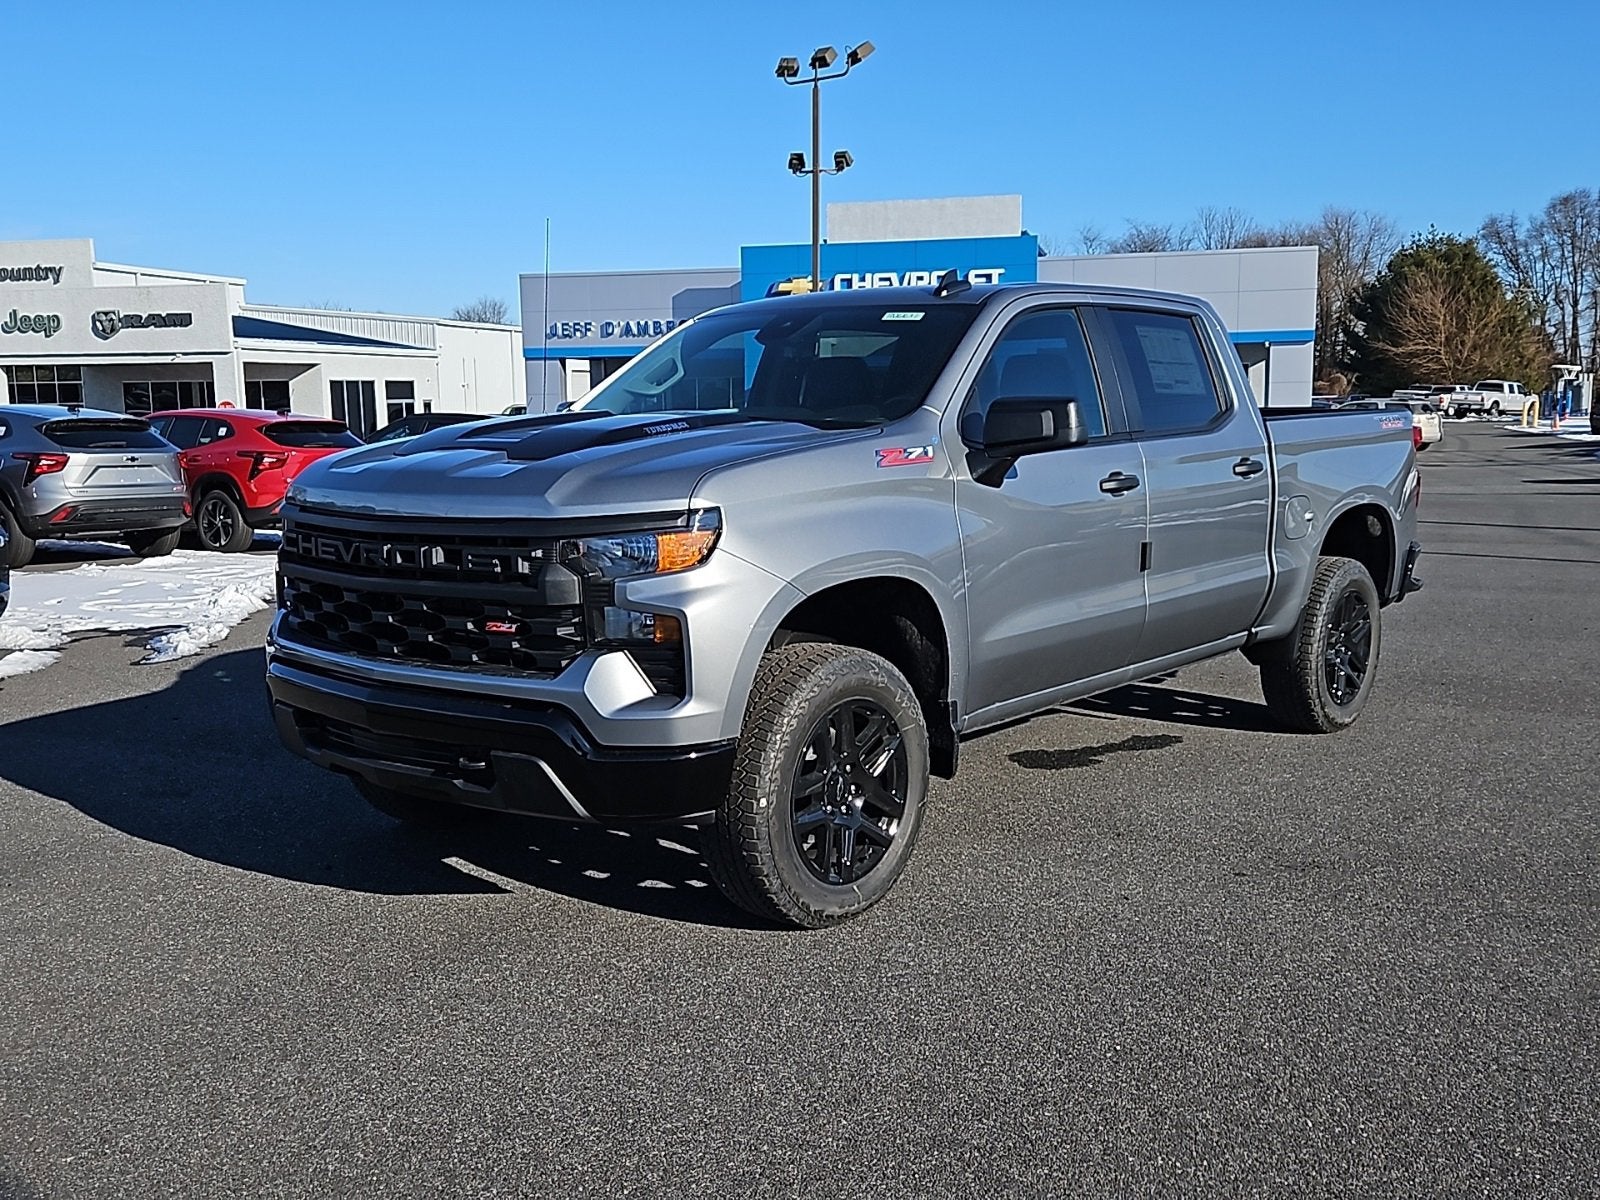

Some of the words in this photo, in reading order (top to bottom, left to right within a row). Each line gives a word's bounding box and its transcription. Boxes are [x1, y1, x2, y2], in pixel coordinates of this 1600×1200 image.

[1, 309, 61, 338] Jeep
[121, 313, 192, 329] RAM
[548, 321, 593, 338] JEFF
[602, 320, 687, 338] D'AMBR
[876, 445, 934, 467] Z71
[283, 533, 533, 574] CHEVROLET
